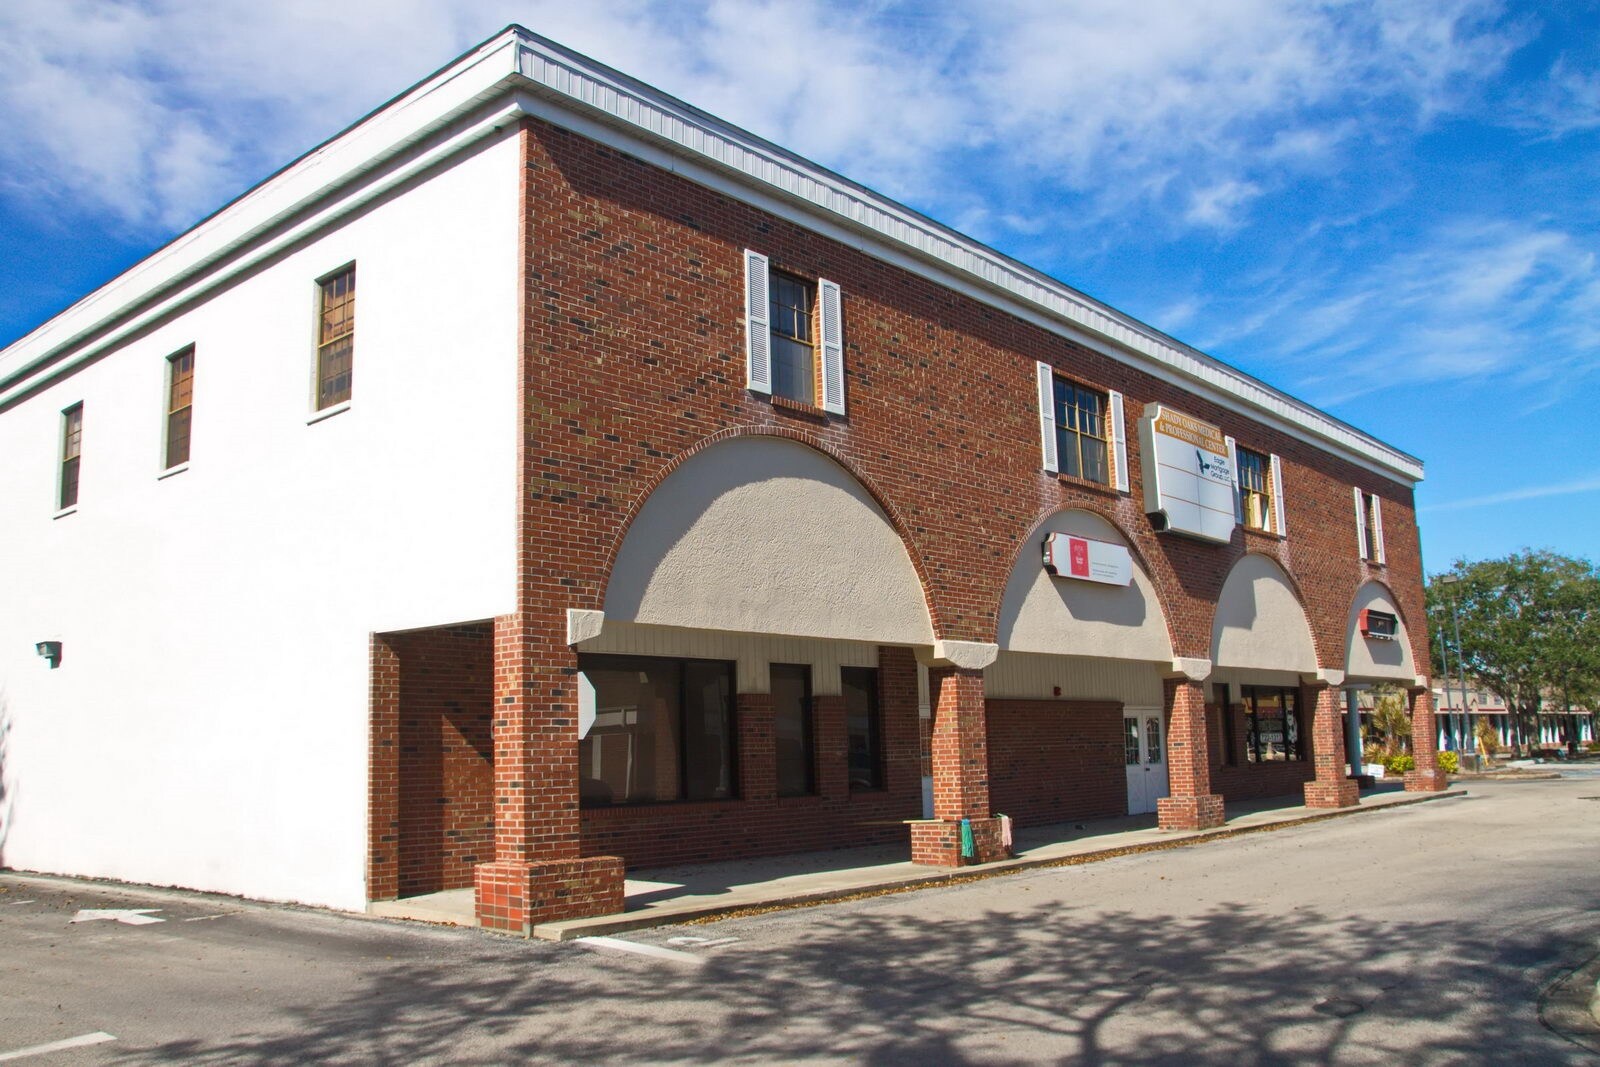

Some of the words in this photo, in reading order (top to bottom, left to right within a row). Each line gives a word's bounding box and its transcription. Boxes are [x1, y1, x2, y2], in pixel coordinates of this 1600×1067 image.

[1159, 421, 1165, 432] &
[1166, 423, 1204, 446] PROFESSIONAL
[1204, 439, 1225, 453] CENTER
[1182, 418, 1198, 432] OAKS
[1198, 425, 1222, 442] MEDICAL
[1210, 464, 1230, 475] Mortgage
